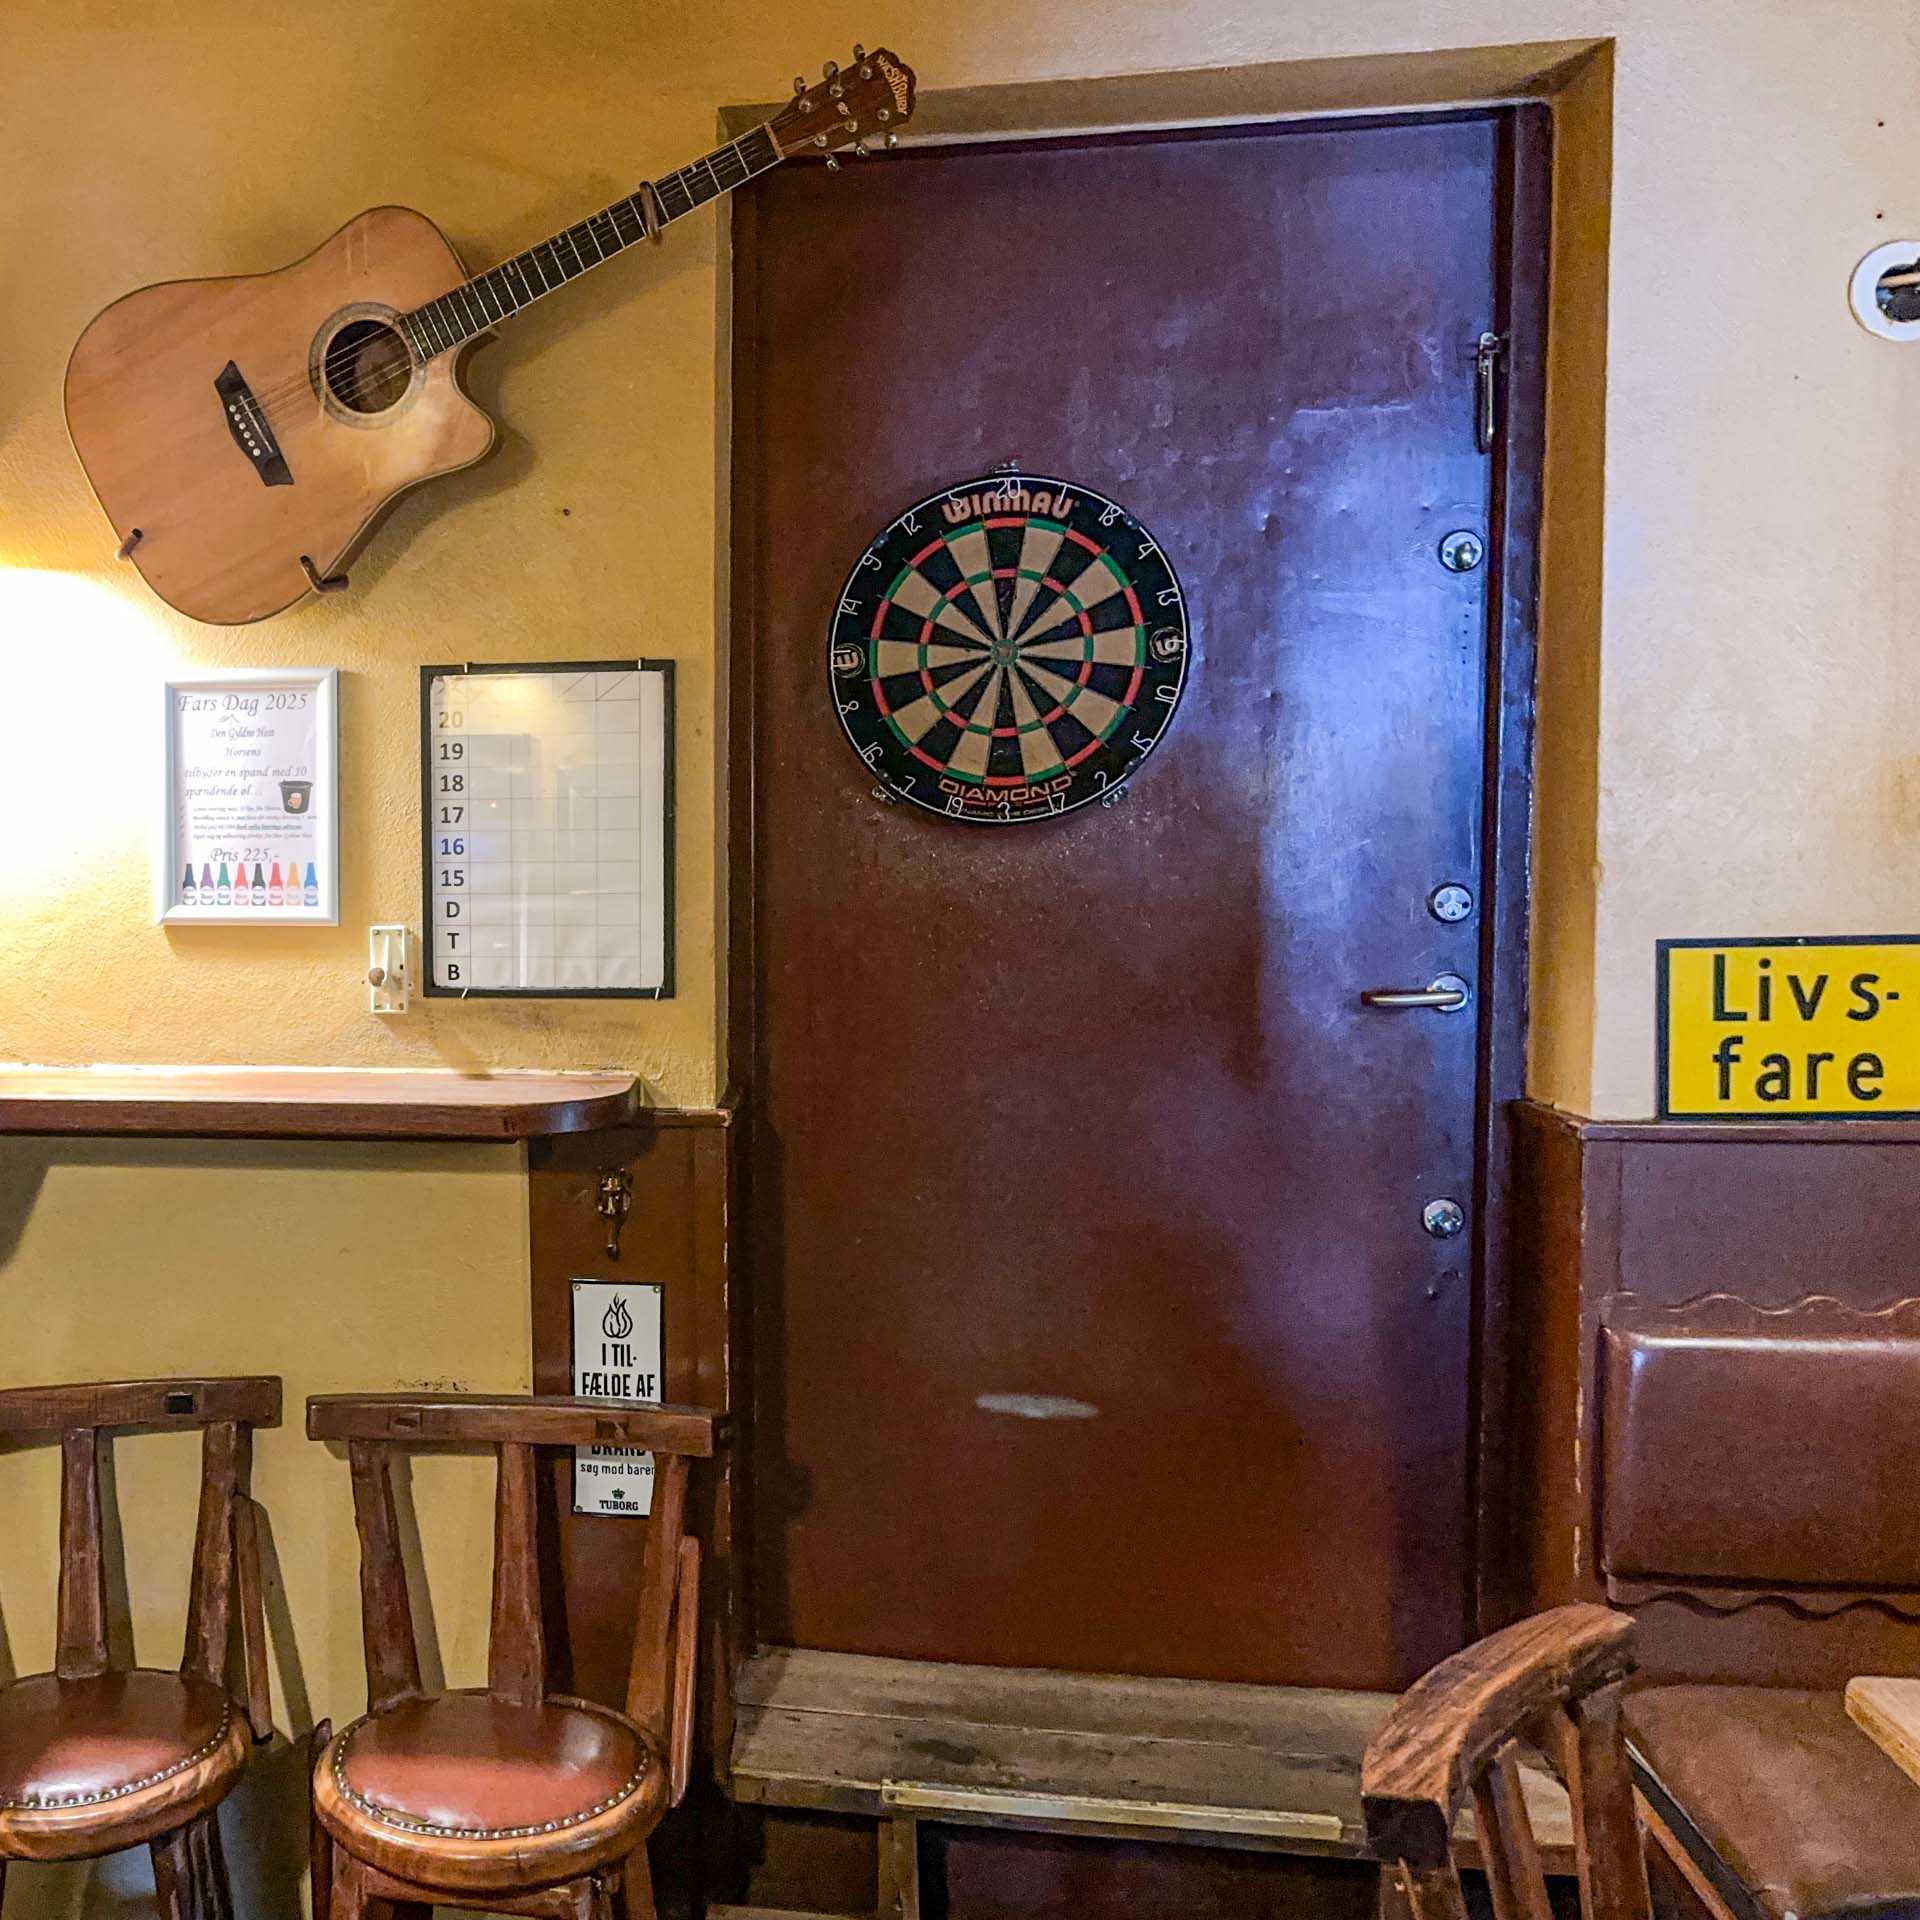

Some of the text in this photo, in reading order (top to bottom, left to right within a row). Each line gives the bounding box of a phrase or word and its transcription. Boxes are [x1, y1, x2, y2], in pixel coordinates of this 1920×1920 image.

[996, 477, 1020, 499] 20
[1098, 503, 1122, 527] 18
[899, 513, 923, 537] 12
[1138, 538, 1156, 560] 4
[861, 554, 882, 571] 9
[1156, 587, 1180, 606] 13
[839, 598, 862, 615] 14
[178, 693, 308, 716] Fars Dag 2025
[838, 700, 859, 715] 8
[439, 711, 463, 729] 20
[439, 743, 465, 761] 19
[225, 769, 236, 777] en
[239, 766, 268, 780] spand
[272, 767, 290, 777] med
[295, 767, 308, 777] 10
[439, 774, 465, 792] 18
[938, 775, 1073, 802] DIAMOND
[945, 794, 964, 816] 19
[997, 800, 1010, 821] 3
[439, 806, 465, 824] 17
[210, 848, 239, 863] Pris
[439, 838, 465, 856] 16
[439, 869, 465, 887] 15
[446, 901, 460, 918] D
[447, 933, 460, 950] T
[447, 964, 460, 981] B
[1712, 953, 1900, 1022] Livs-
[1712, 1035, 1884, 1102] fare
[601, 1343, 606, 1366] I
[581, 1372, 656, 1398] FÆLDE AF
[580, 1463, 599, 1476] søg
[602, 1463, 624, 1475] mod
[599, 1500, 639, 1511] TUBORG
